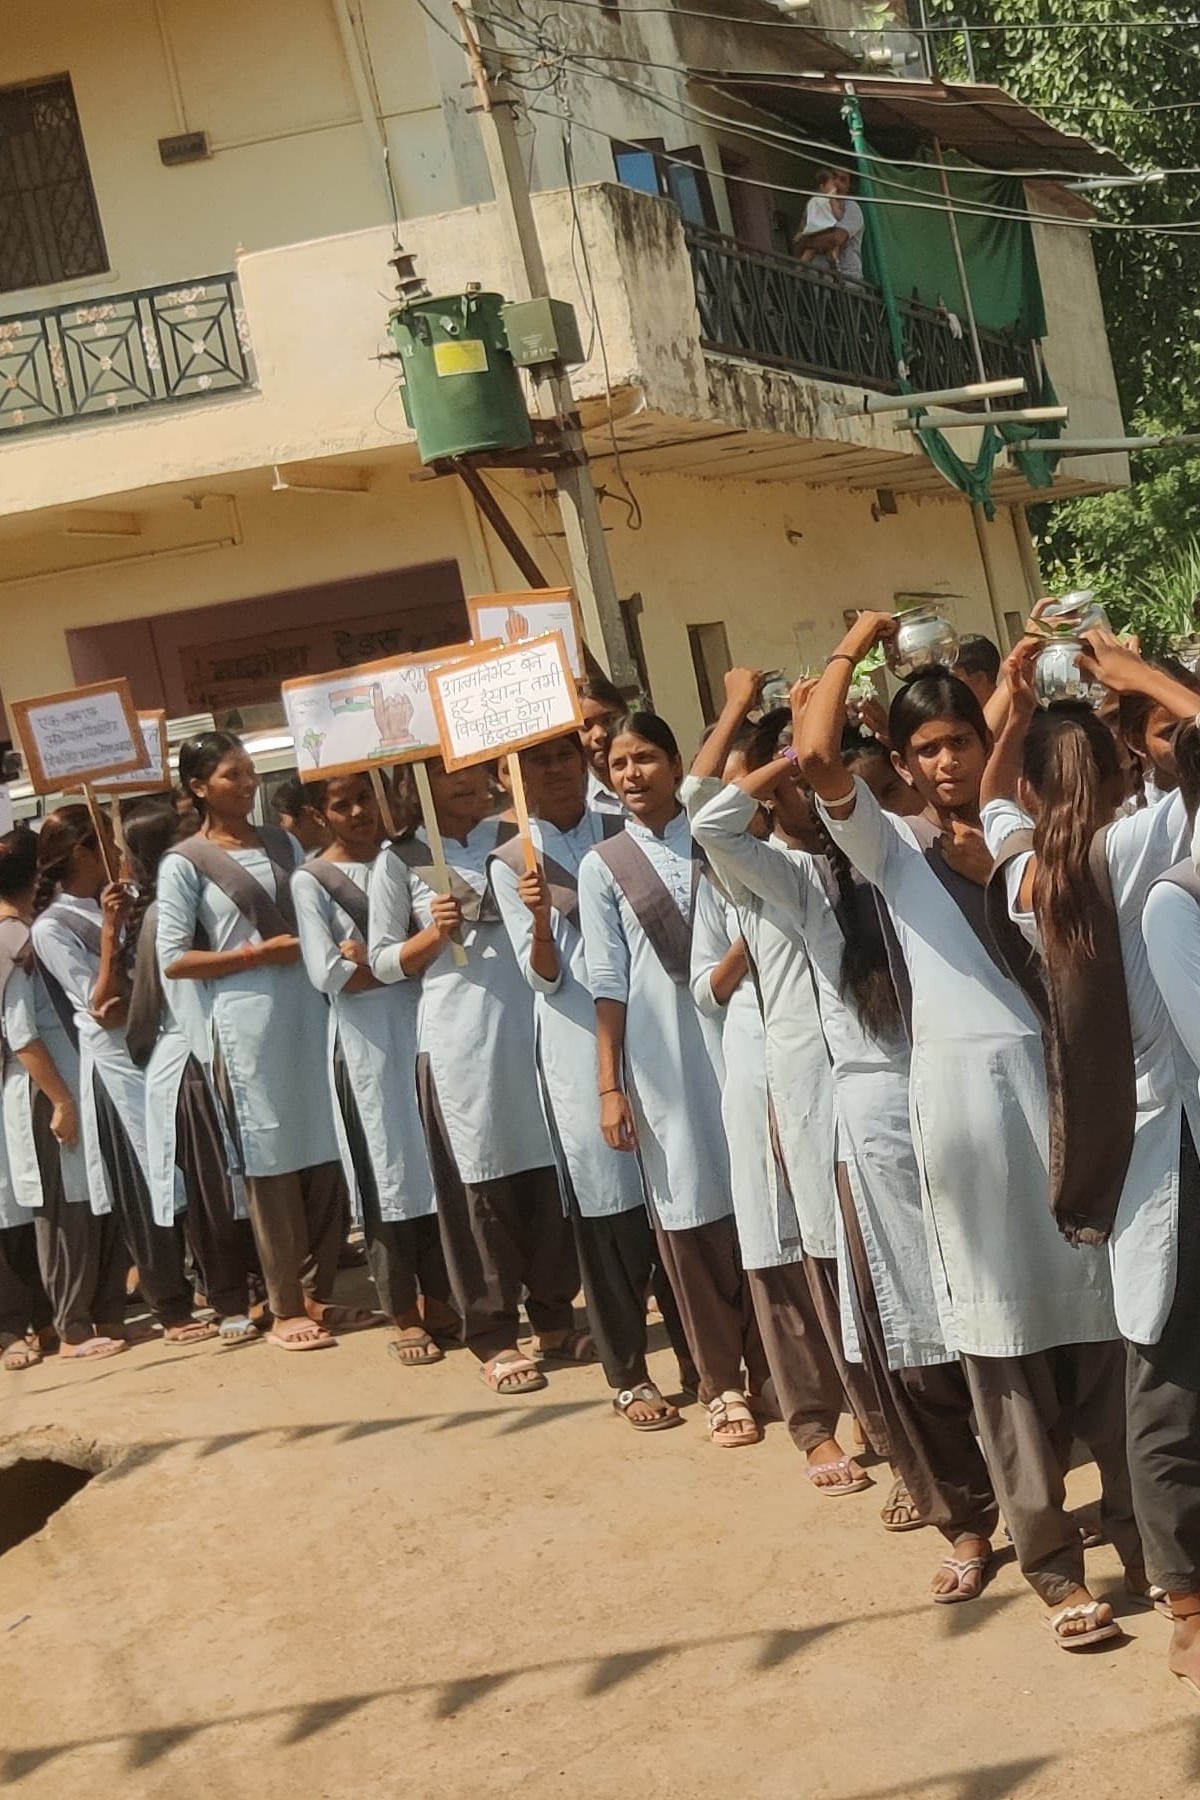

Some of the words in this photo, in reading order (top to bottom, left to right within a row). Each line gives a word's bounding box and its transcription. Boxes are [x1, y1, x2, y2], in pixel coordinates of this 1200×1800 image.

[450, 695, 475, 719] हर
[531, 662, 561, 690] तभी
[515, 696, 556, 721] होगा
